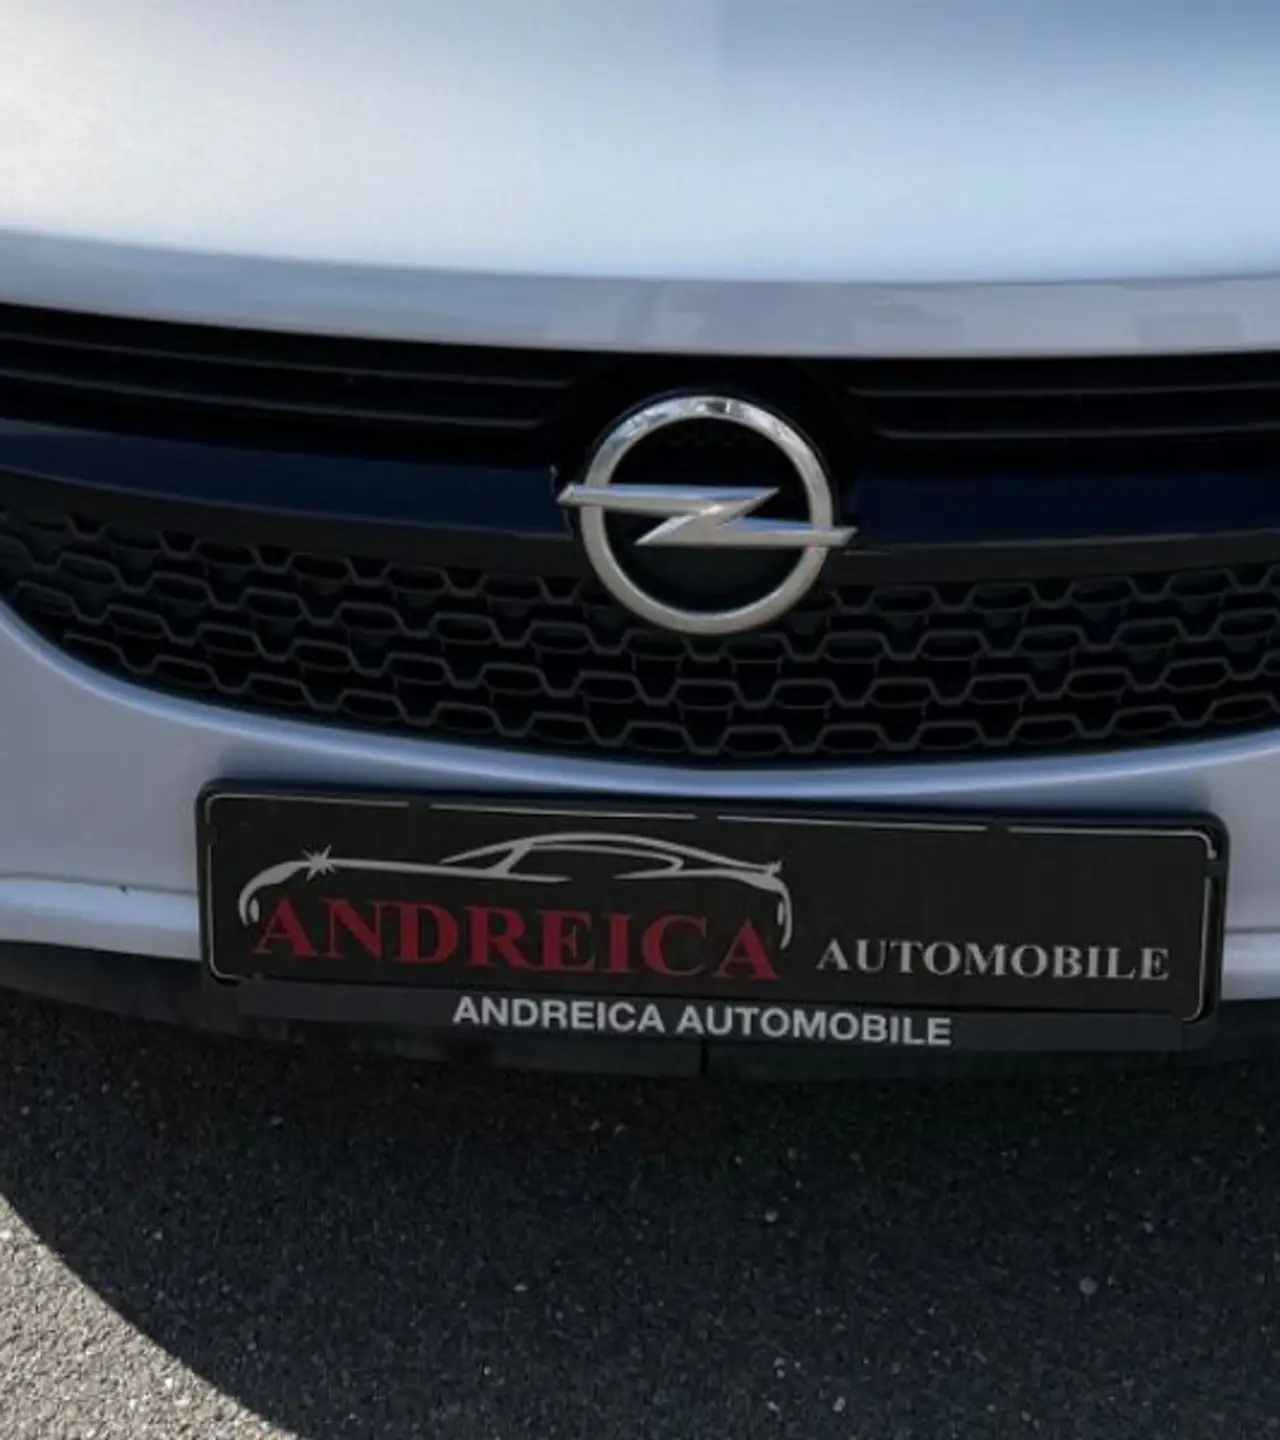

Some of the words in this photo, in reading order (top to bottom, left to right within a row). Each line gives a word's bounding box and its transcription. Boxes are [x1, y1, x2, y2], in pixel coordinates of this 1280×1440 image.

[250, 895, 781, 980] ANDREICA
[815, 937, 1170, 981] AUTOMOBILE
[452, 994, 666, 1033] ANDREICA
[675, 1005, 953, 1046] AUTOMOBILE
